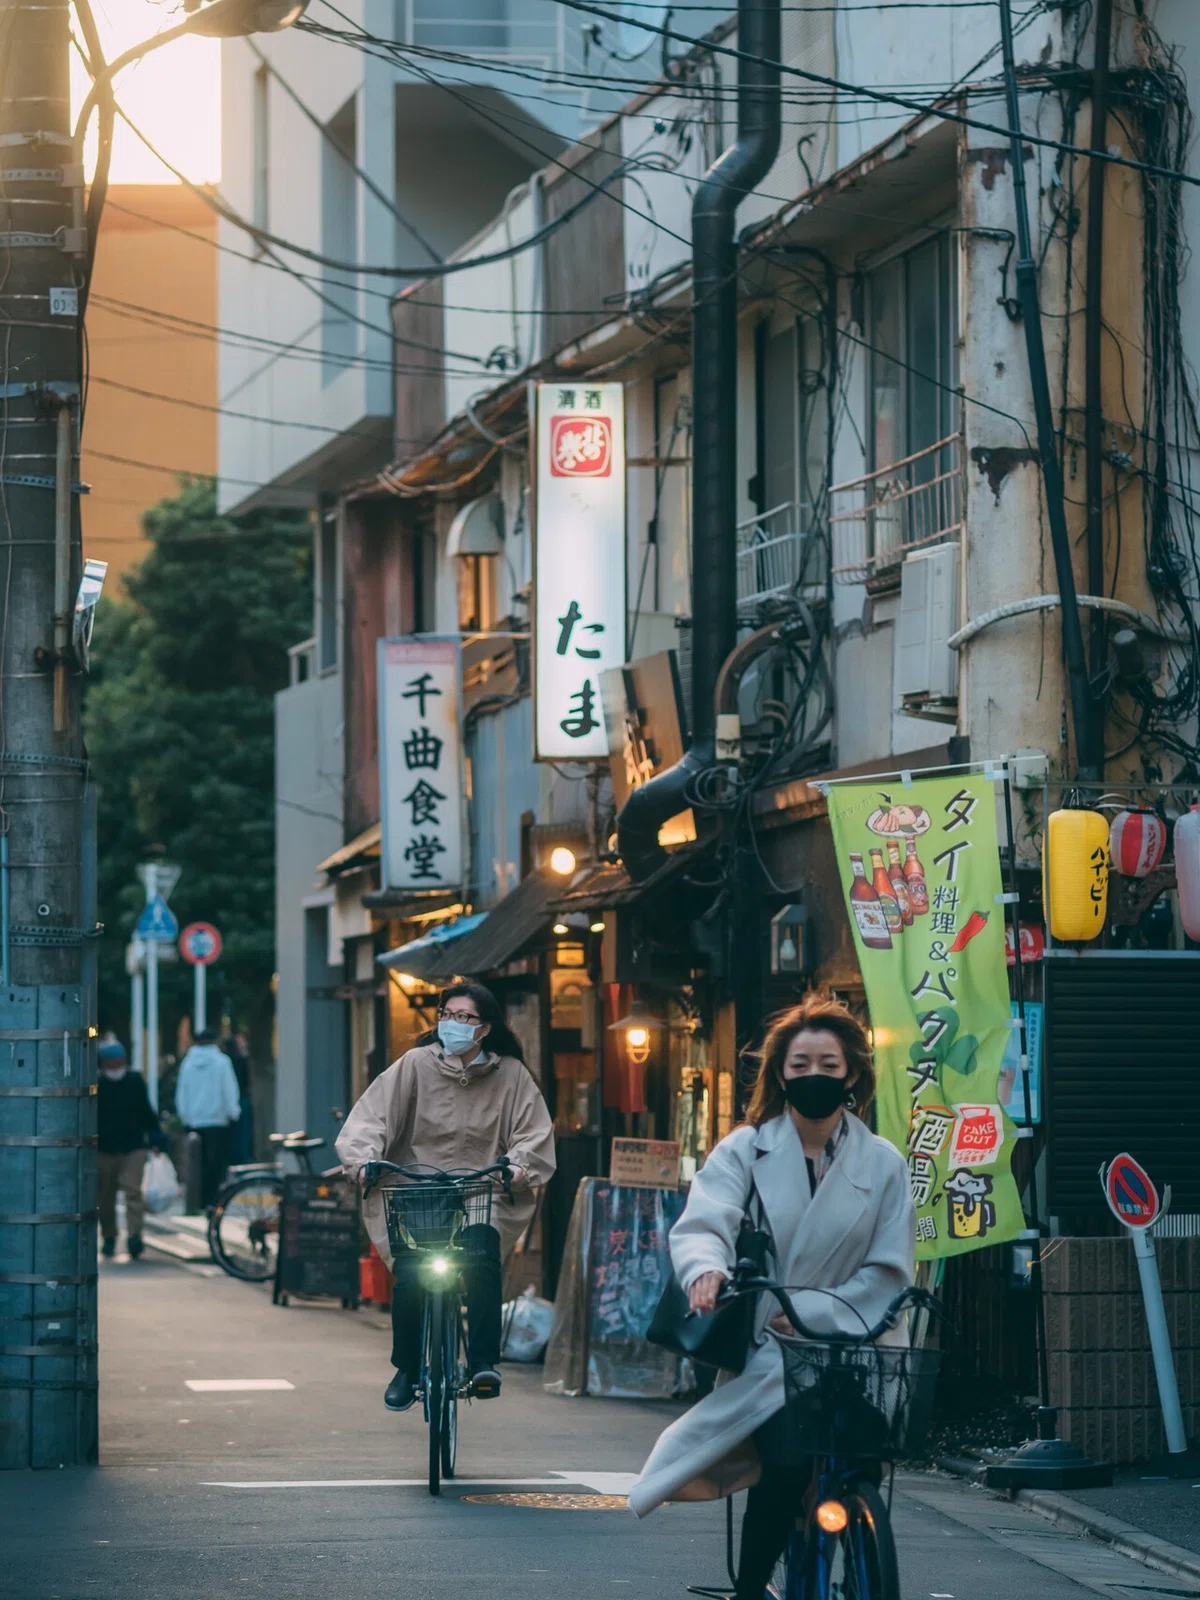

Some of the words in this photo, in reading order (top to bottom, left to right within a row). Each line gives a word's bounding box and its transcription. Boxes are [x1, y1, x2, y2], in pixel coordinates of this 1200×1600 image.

[557, 389, 602, 409] 清酒
[556, 600, 605, 738] たま
[401, 672, 448, 880] 千曲食堂
[964, 1122, 994, 1135] TAKE
[963, 1135, 991, 1145] OUT
[1118, 1202, 1151, 1215] 駐車禁止
